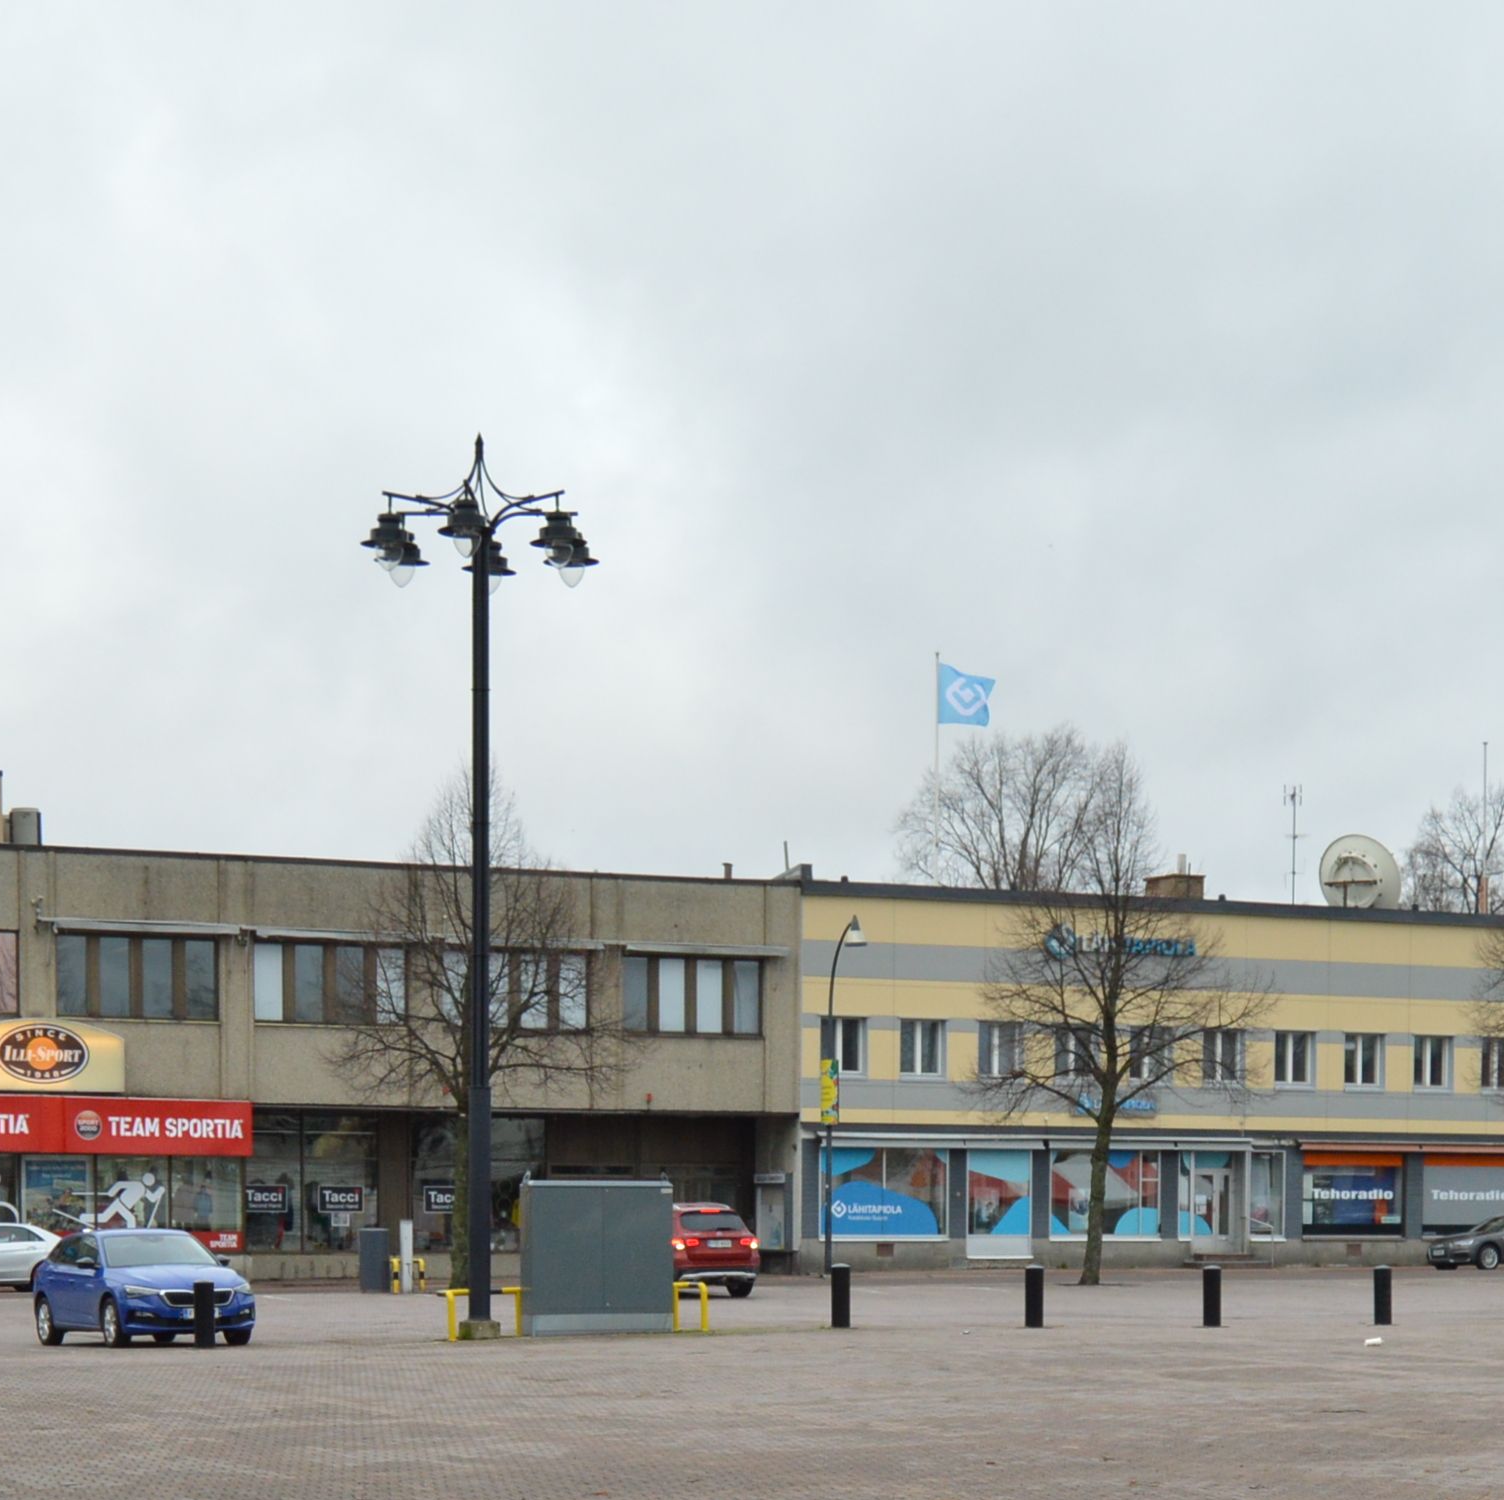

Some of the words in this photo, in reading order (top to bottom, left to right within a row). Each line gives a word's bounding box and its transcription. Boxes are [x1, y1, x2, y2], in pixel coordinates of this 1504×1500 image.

[15, 1029, 67, 1042] SINCE
[108, 1116, 160, 1138] TEAM
[165, 1118, 244, 1139] SPORTIA
[246, 1187, 283, 1202] Tacci
[323, 1187, 360, 1202] Tacci
[1312, 1187, 1394, 1200] Tehoradio
[848, 1202, 902, 1214] LÄHITAPIOLA
[209, 1240, 238, 1248] SPORTIA
